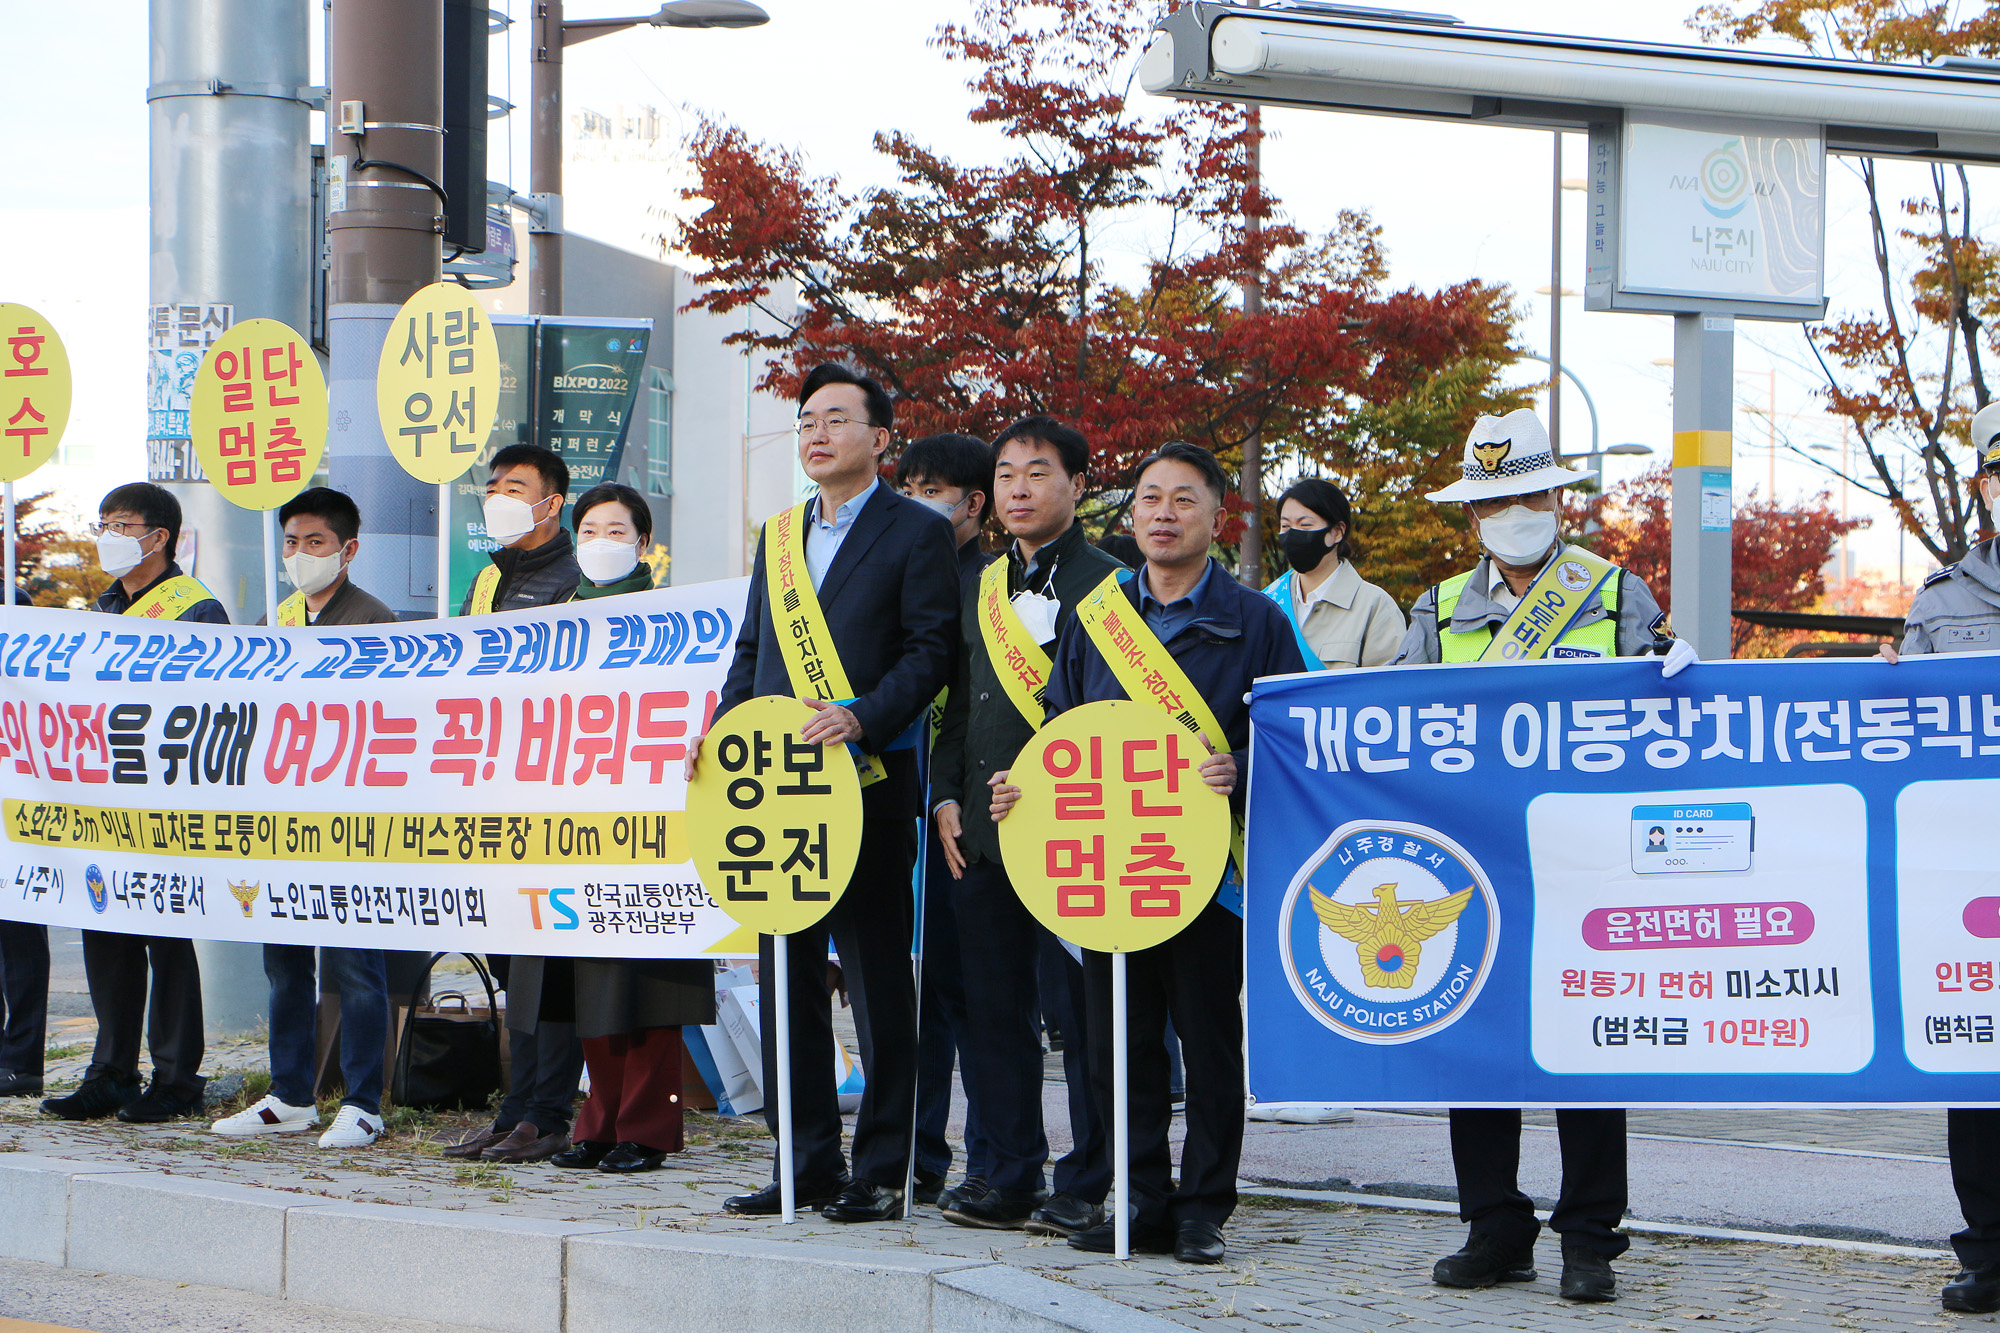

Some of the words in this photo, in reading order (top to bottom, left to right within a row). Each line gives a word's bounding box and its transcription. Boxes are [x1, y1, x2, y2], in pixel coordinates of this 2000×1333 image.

[1692, 225, 1754, 258] 나주시
[1691, 258, 1722, 272] NAJU
[1725, 260, 1755, 274] CITY
[5, 327, 48, 377] 호
[400, 307, 479, 378] 사람
[214, 342, 303, 412] 일단
[500, 377, 517, 388] 22
[553, 373, 598, 388] BIXPO
[598, 378, 628, 390] 2022
[399, 386, 476, 457] 우선
[219, 418, 306, 486] 멈춤
[301, 633, 463, 679] 교통안전
[467, 617, 590, 676] 릴레이
[598, 608, 733, 670] 캠페인
[1502, 590, 1566, 659] 오토바이
[0, 700, 40, 779] 의
[39, 701, 152, 784] 안전을
[159, 702, 258, 785] 위해
[264, 700, 417, 787] 여기는
[430, 696, 502, 787] 꼭!
[1289, 703, 1477, 774] 개인형
[718, 730, 832, 810] 양보
[1042, 734, 1190, 820] 일단
[16, 803, 67, 841] 소화전
[73, 809, 99, 843] 5m
[101, 811, 136, 848] 이내
[149, 811, 206, 851] 교차로
[286, 817, 321, 853] 5m
[331, 816, 375, 857] 이내
[384, 816, 394, 857] /
[403, 816, 532, 860] 버스정류장
[543, 818, 601, 856] 10m
[612, 815, 666, 859] 이내
[1673, 809, 1683, 818] ID
[1686, 809, 1714, 818] CARD
[15, 865, 64, 903] 나주시
[718, 823, 830, 901] 운전
[1045, 833, 1191, 917] 멈춤
[112, 870, 206, 915] 나주경찰서
[267, 882, 487, 927] 노인교통안전지킴이회
[518, 888, 579, 930] TS
[588, 911, 696, 934] 광주전남본부
[1606, 908, 1721, 943] 운전면허
[1734, 907, 1794, 939] 필요
[1306, 967, 1343, 1010] NAJU
[1343, 1003, 1408, 1027] POLICE
[1412, 963, 1474, 1021] STATION
[1560, 969, 1645, 997] 원동기
[1659, 971, 1713, 999] 면허
[1726, 967, 1839, 999] 미소지시
[1935, 961, 2000, 993] 인명
[1592, 1015, 1689, 1048] (범칙금
[1703, 1017, 1809, 1048] 10만원)
[1925, 1015, 1994, 1045] (범칙금
